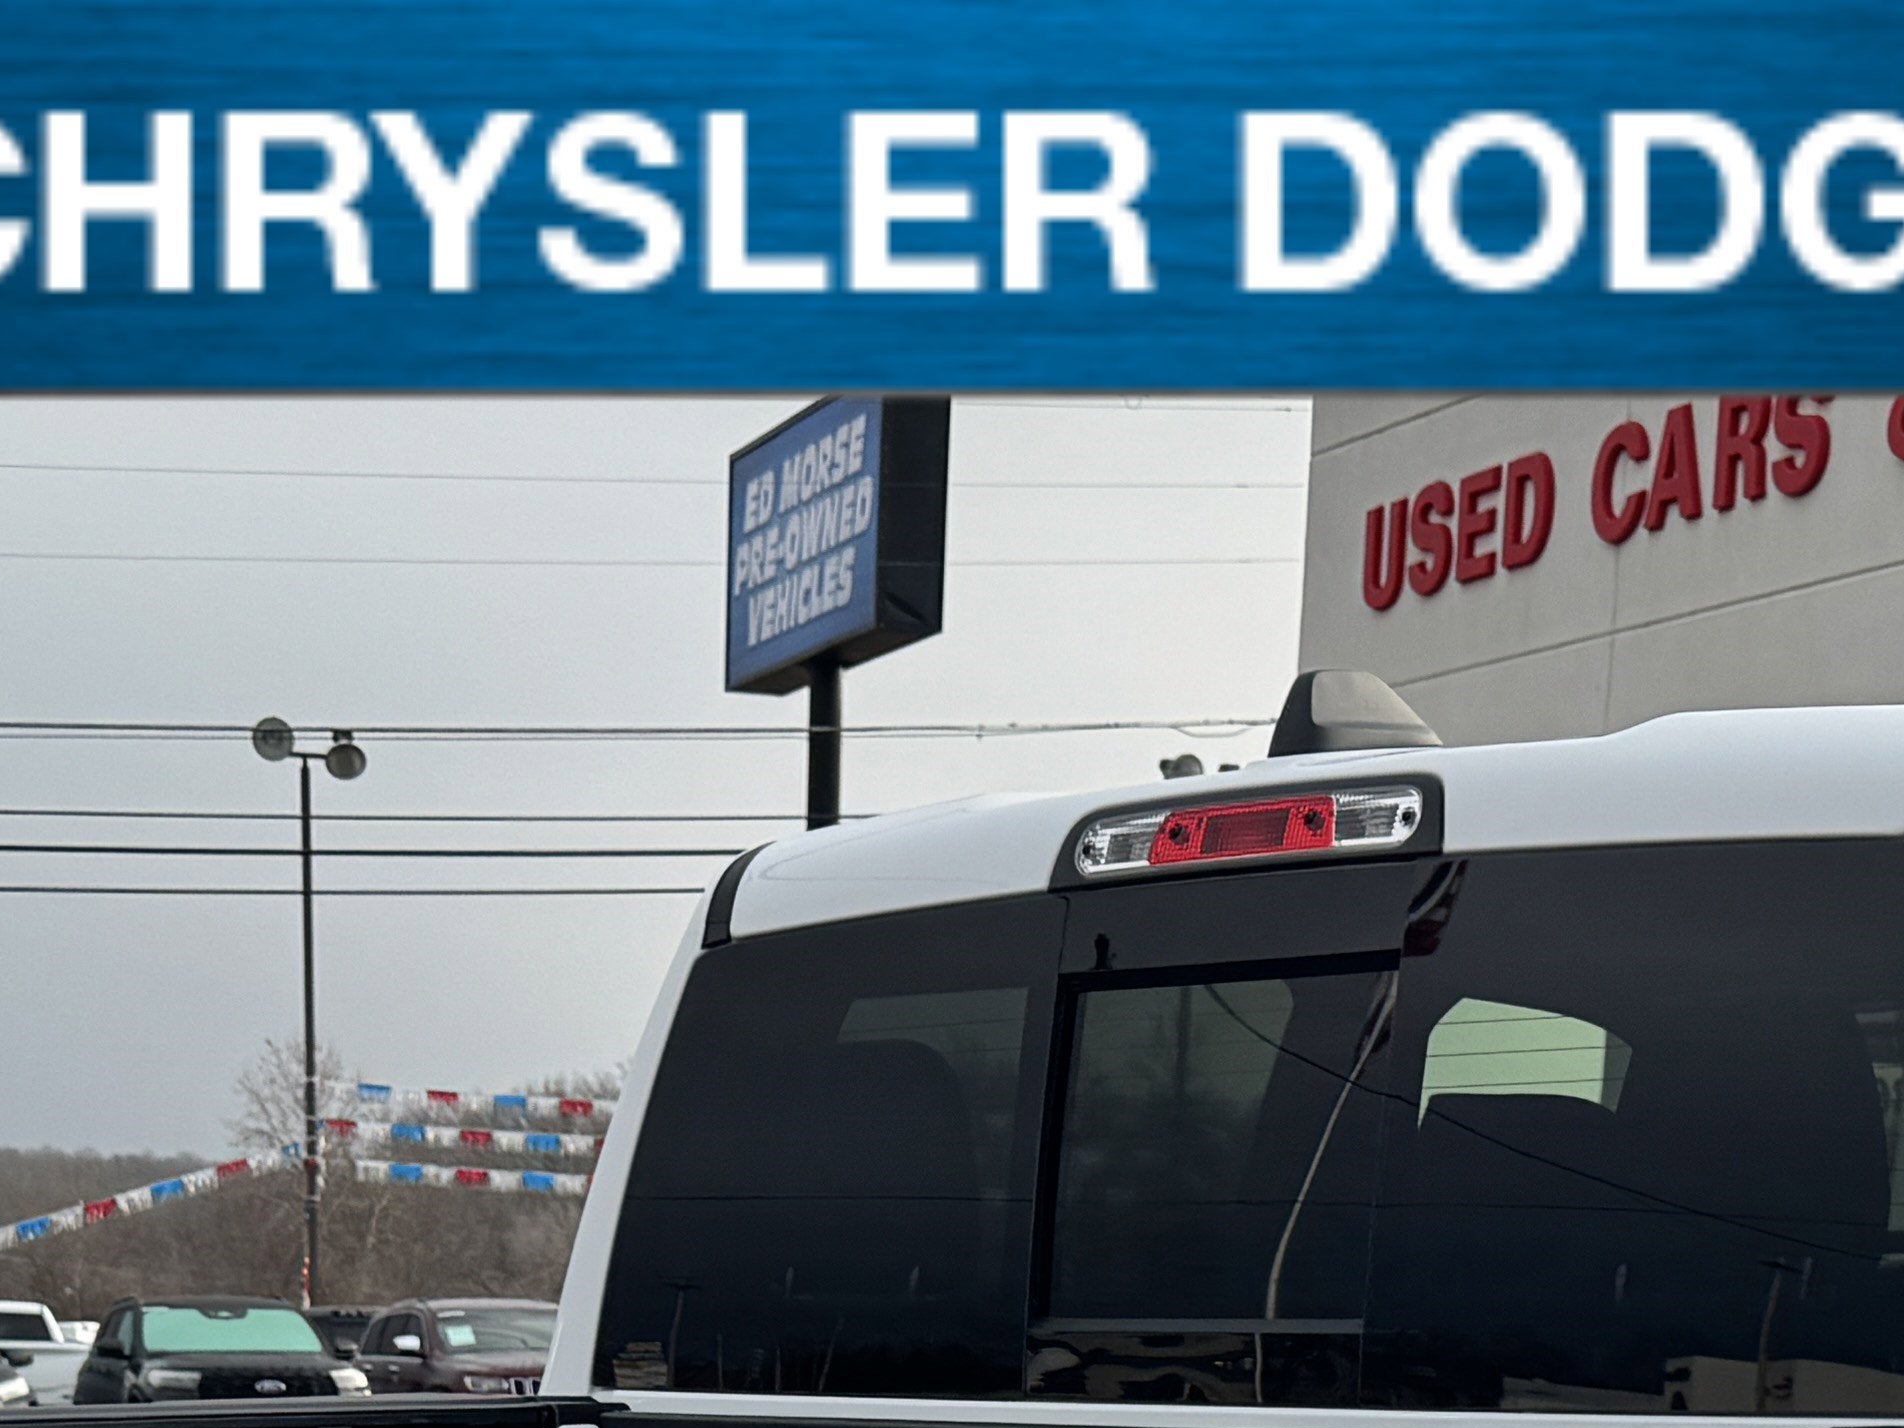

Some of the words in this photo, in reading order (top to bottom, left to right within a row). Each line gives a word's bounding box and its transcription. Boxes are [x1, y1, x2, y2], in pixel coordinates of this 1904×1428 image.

[743, 469, 776, 534] ED
[778, 412, 867, 514] MORSE
[1362, 451, 1556, 611] USED
[1590, 395, 1831, 545] CARS
[734, 475, 873, 597] PRE-OWNED
[747, 547, 856, 647] VEHICLES
